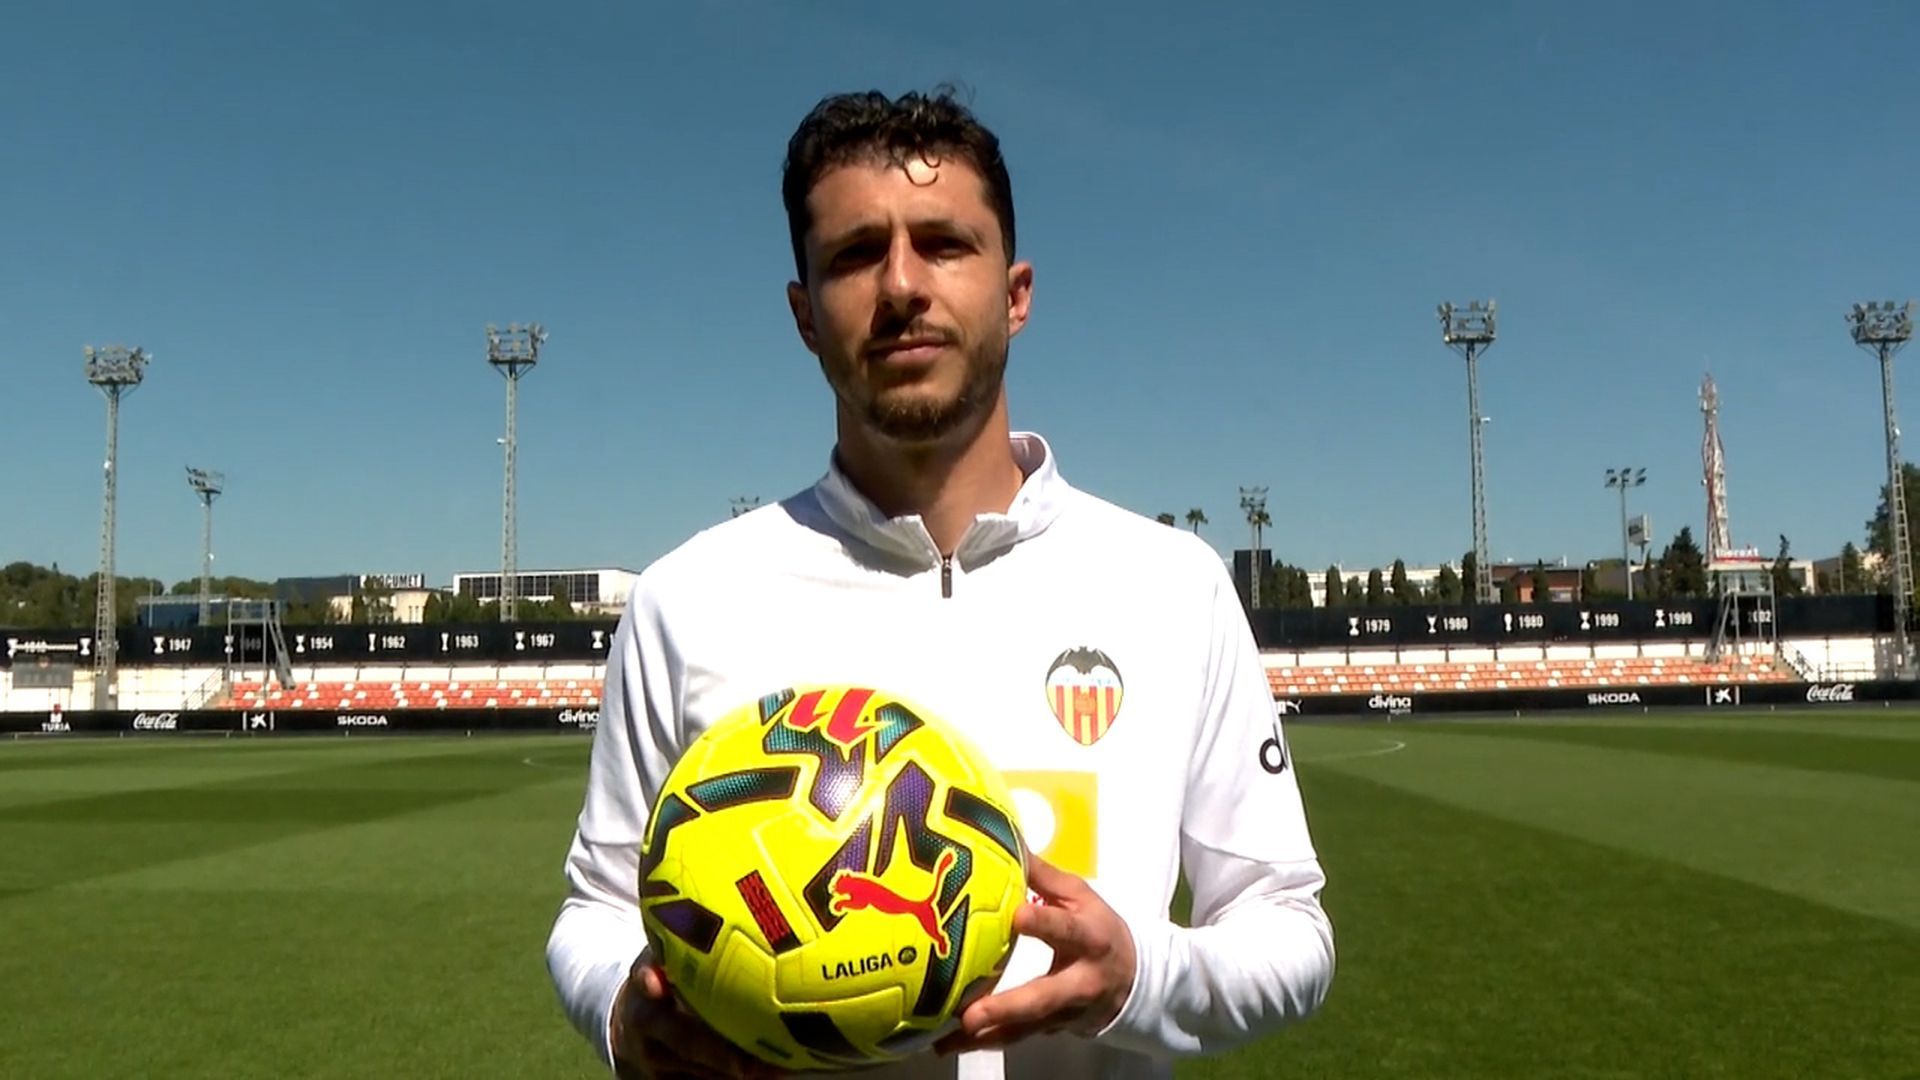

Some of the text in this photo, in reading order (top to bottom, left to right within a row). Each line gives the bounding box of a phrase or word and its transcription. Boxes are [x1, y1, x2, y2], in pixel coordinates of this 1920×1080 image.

[1365, 618, 1391, 632] 1979
[1443, 617, 1468, 631] 1980
[1518, 614, 1544, 629] 1980
[1594, 613, 1619, 627] 1999
[1668, 611, 1693, 626] 1999
[169, 638, 192, 651] 1947
[310, 636, 333, 649] 1954
[382, 635, 406, 649] 1962
[455, 635, 479, 648] 1963
[530, 634, 555, 647] 1967
[1368, 694, 1412, 709] divina
[41, 722, 71, 732] TURIA
[821, 952, 894, 980] LALIGA
